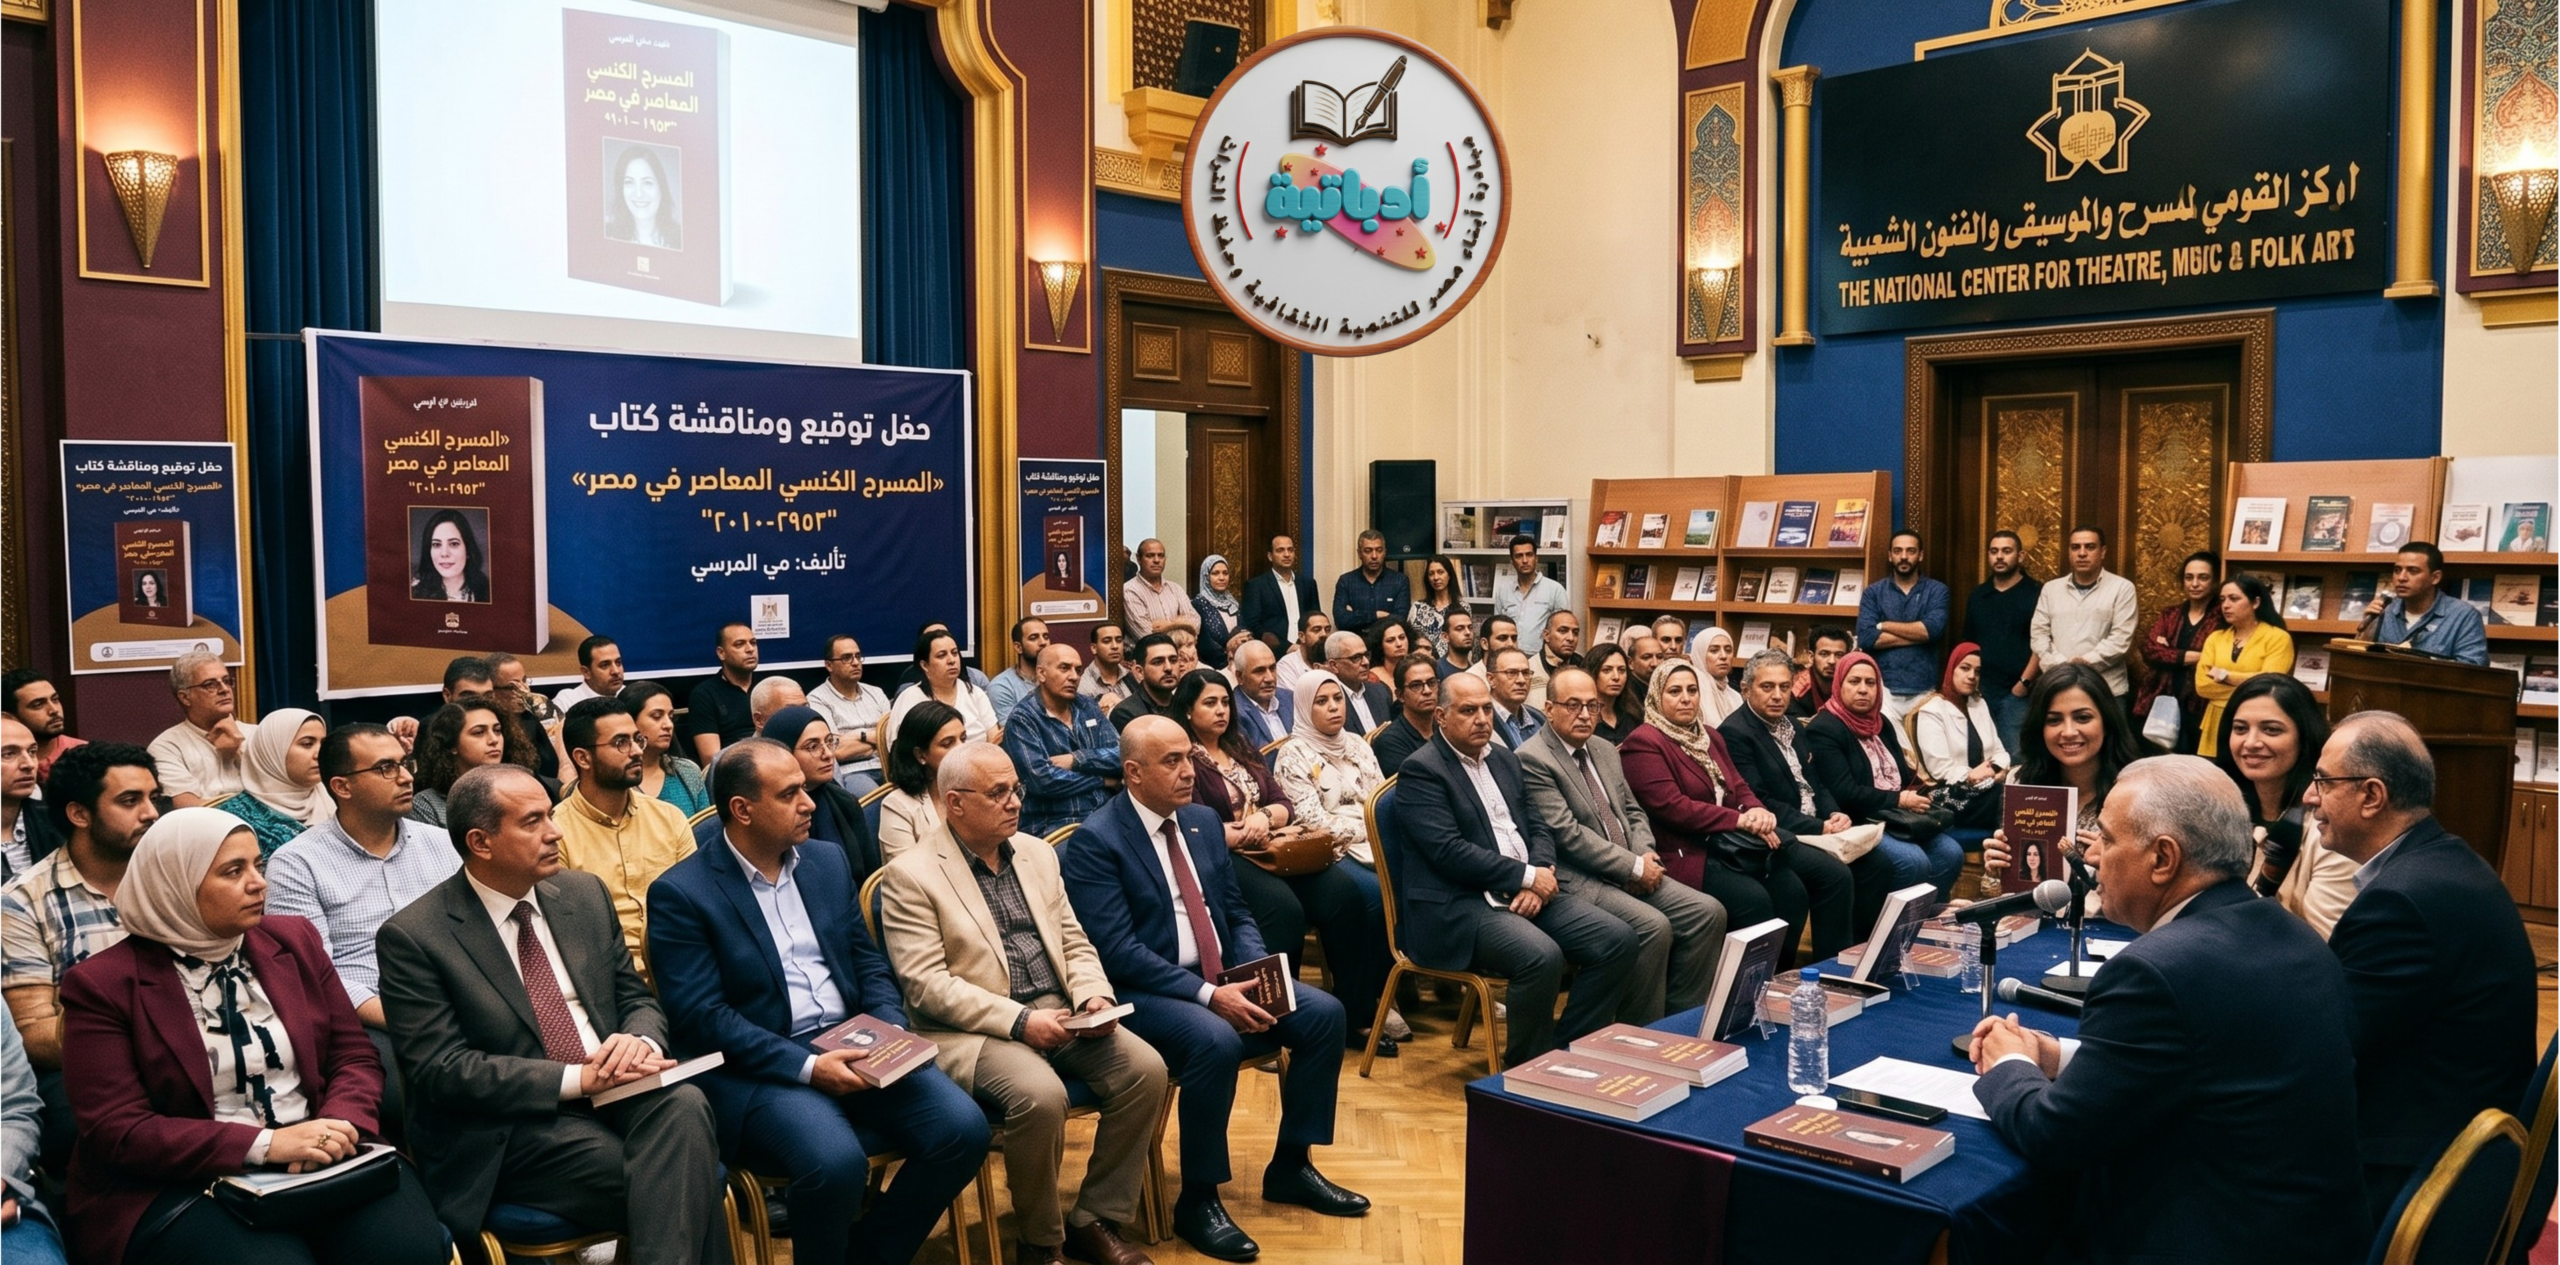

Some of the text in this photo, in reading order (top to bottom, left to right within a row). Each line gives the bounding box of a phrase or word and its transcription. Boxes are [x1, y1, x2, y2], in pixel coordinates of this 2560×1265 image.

[586, 61, 694, 89] المسرح الكنسي
[584, 87, 699, 114] المعاصر في مصر
[2201, 171, 2290, 235] القومي
[1920, 209, 2000, 258] والفنون
[2004, 195, 2113, 250] والموسيقى
[1838, 215, 1916, 267] الشعبية
[1838, 279, 1870, 308] THE
[1874, 271, 1957, 305] NATIONAL
[1961, 263, 2030, 297] CENTER
[2034, 259, 2071, 290] FOR
[2075, 250, 2167, 286] THEATRE,
[2250, 233, 2306, 269] FOLK
[2311, 228, 2355, 264] ART
[384, 429, 510, 454] «المسرح الكنسي
[589, 402, 931, 447] حفل توقيع ومناقشة كتاب
[75, 460, 223, 475] حفل توقيع ومناقشة كتاب
[386, 454, 510, 479] المعاصر في مصر
[572, 467, 945, 503] «المسرح الكنسي المعاصر في مصر»
[691, 546, 847, 582] تأليف: مي المرسي
